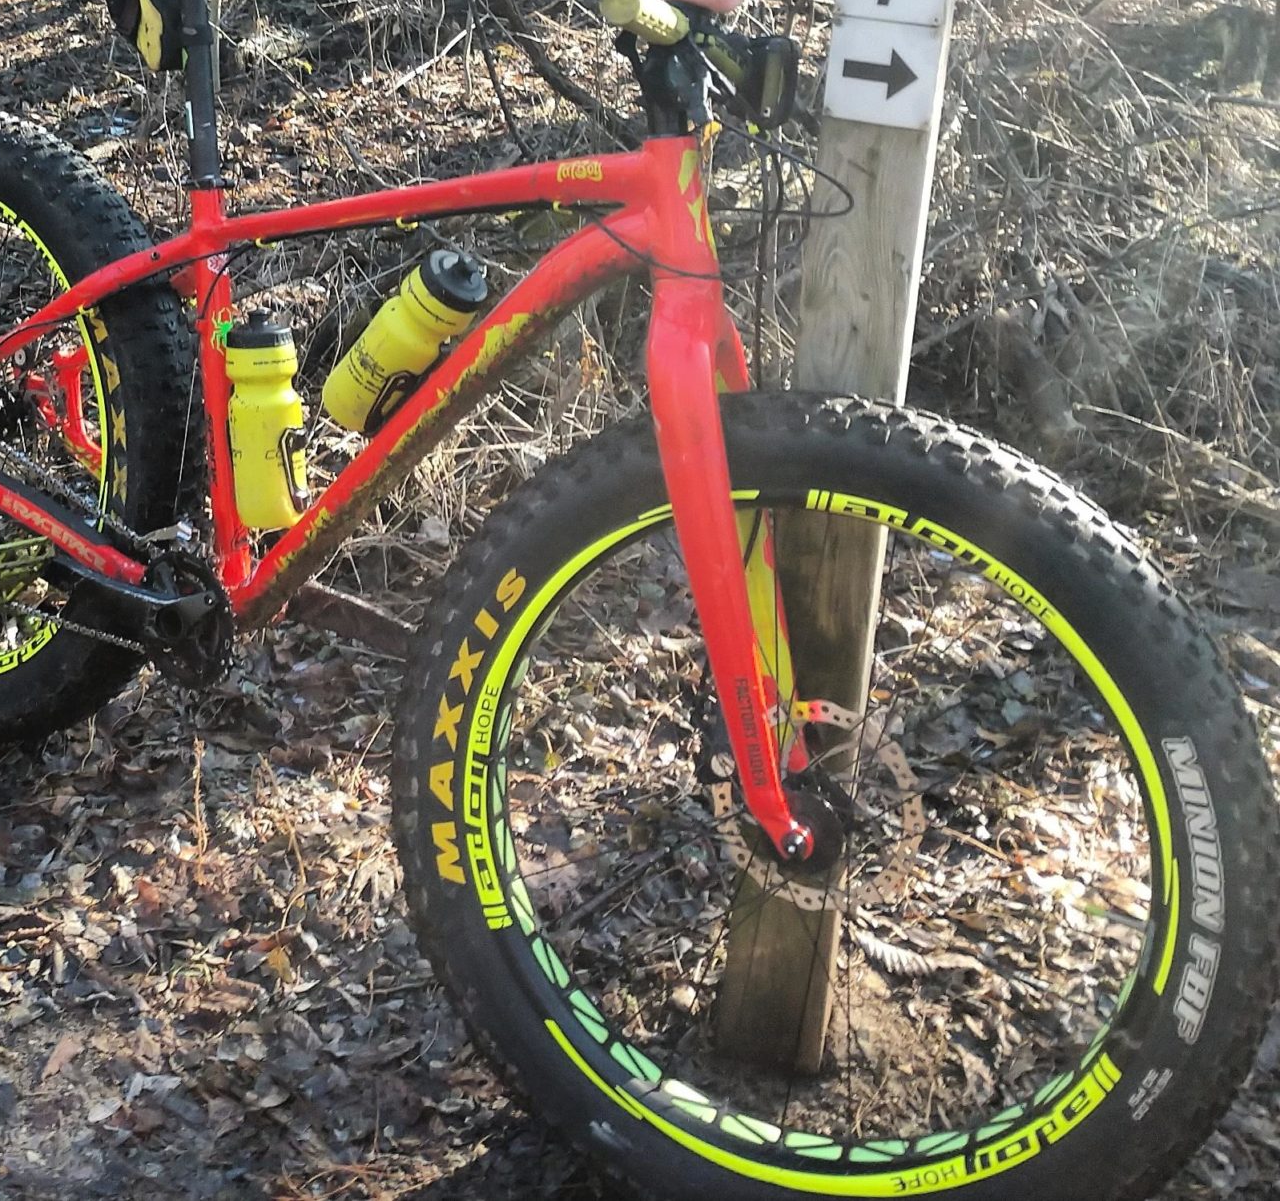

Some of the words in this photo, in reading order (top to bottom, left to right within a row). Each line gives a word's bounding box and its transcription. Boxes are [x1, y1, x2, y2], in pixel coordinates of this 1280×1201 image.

[994, 571, 1057, 622] HOPE
[429, 567, 527, 884] MAXXIS
[474, 685, 500, 745] HOPE
[1161, 735, 1225, 933] MINION
[1173, 933, 1220, 1045] FBF
[892, 1163, 958, 1193] HOPE
